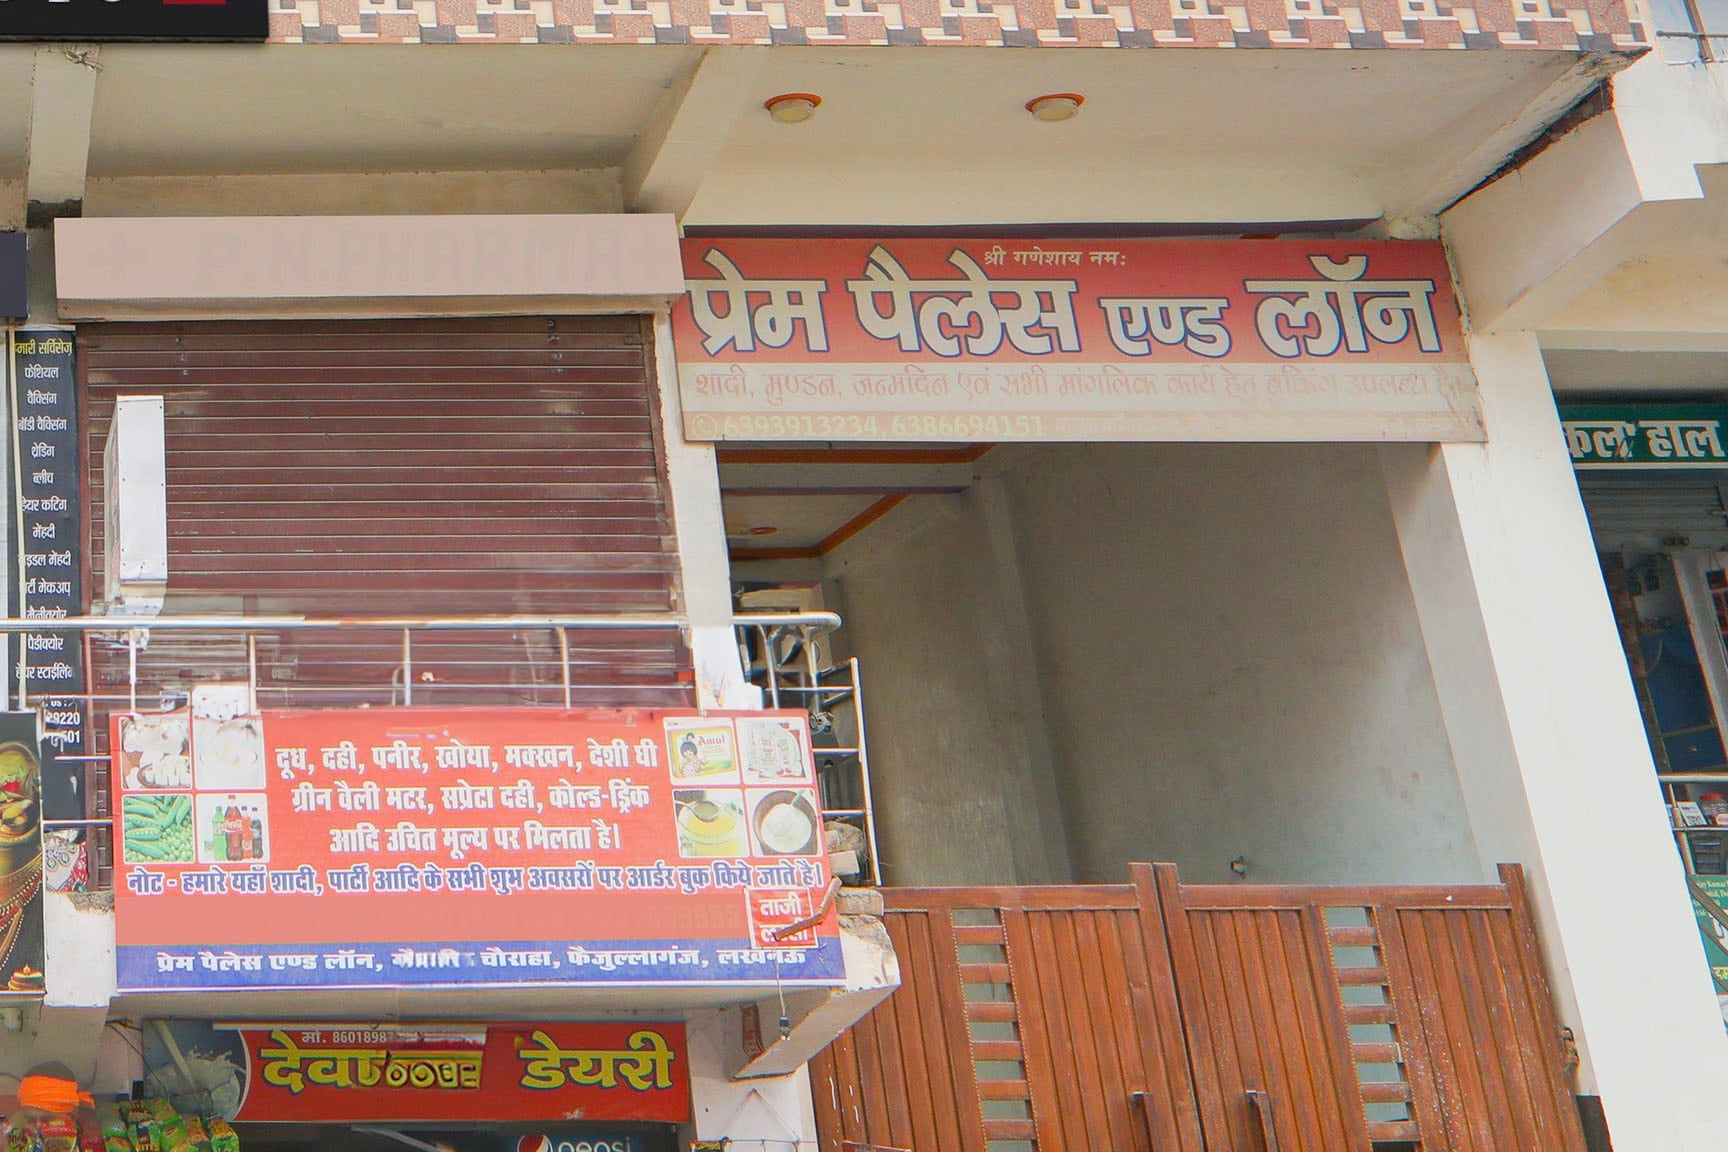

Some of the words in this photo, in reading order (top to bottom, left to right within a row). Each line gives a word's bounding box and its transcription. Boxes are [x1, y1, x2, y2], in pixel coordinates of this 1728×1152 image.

[984, 245, 1007, 265] श्री
[1013, 246, 1083, 265] गणेशाय
[685, 248, 828, 356] प्रेम
[846, 246, 1081, 357] पैलेस
[1098, 295, 1231, 358] एण्ड
[1245, 254, 1443, 358] लॉन
[15, 339, 36, 355] मारी
[24, 364, 59, 379] फेशियल
[695, 364, 754, 399] शादी,
[852, 364, 950, 396] जन्मदिन
[956, 366, 992, 400] एवं
[998, 364, 1050, 397] सभी
[1638, 419, 1726, 458] हाल
[275, 746, 315, 779] दूध,
[321, 741, 365, 774] दही,
[372, 740, 430, 774] पनीर,
[435, 738, 499, 773] खोया,
[504, 744, 583, 773] मक्खन,
[586, 737, 629, 768] देशी
[634, 738, 659, 768] घी
[697, 734, 726, 746] Amul
[291, 781, 332, 813] ग्रीन
[334, 780, 380, 812] वैली
[385, 786, 435, 815] मटर,
[440, 779, 493, 810] सप्रेटा
[499, 779, 544, 813] दही,
[329, 822, 379, 853] आदि
[385, 821, 437, 852] उचित
[442, 827, 488, 860] मूल्य
[494, 827, 520, 850] पर
[524, 820, 591, 850] मिलता
[127, 866, 166, 894] नोट
[181, 865, 229, 894] हमारे
[269, 864, 323, 896] शादी,
[328, 862, 369, 893] पार्टी
[373, 863, 420, 893] आदि
[422, 862, 444, 892] के
[446, 861, 486, 891] सभी
[489, 866, 525, 895] शुभ
[528, 860, 595, 890] अवसरों
[598, 866, 624, 889] पर
[626, 860, 676, 889] आर्डर
[678, 865, 710, 894] बुक
[713, 859, 752, 889] किये
[756, 859, 798, 888] जाते
[758, 892, 803, 917] ताजी
[156, 951, 195, 972] प्रेम
[200, 950, 262, 971] पैलेस
[269, 954, 318, 970] एण्ड
[324, 949, 383, 973] लॉन,
[480, 947, 560, 969] चौराहा,
[716, 949, 806, 966] लखनऊ
[519, 1030, 675, 1090] डेयरी
